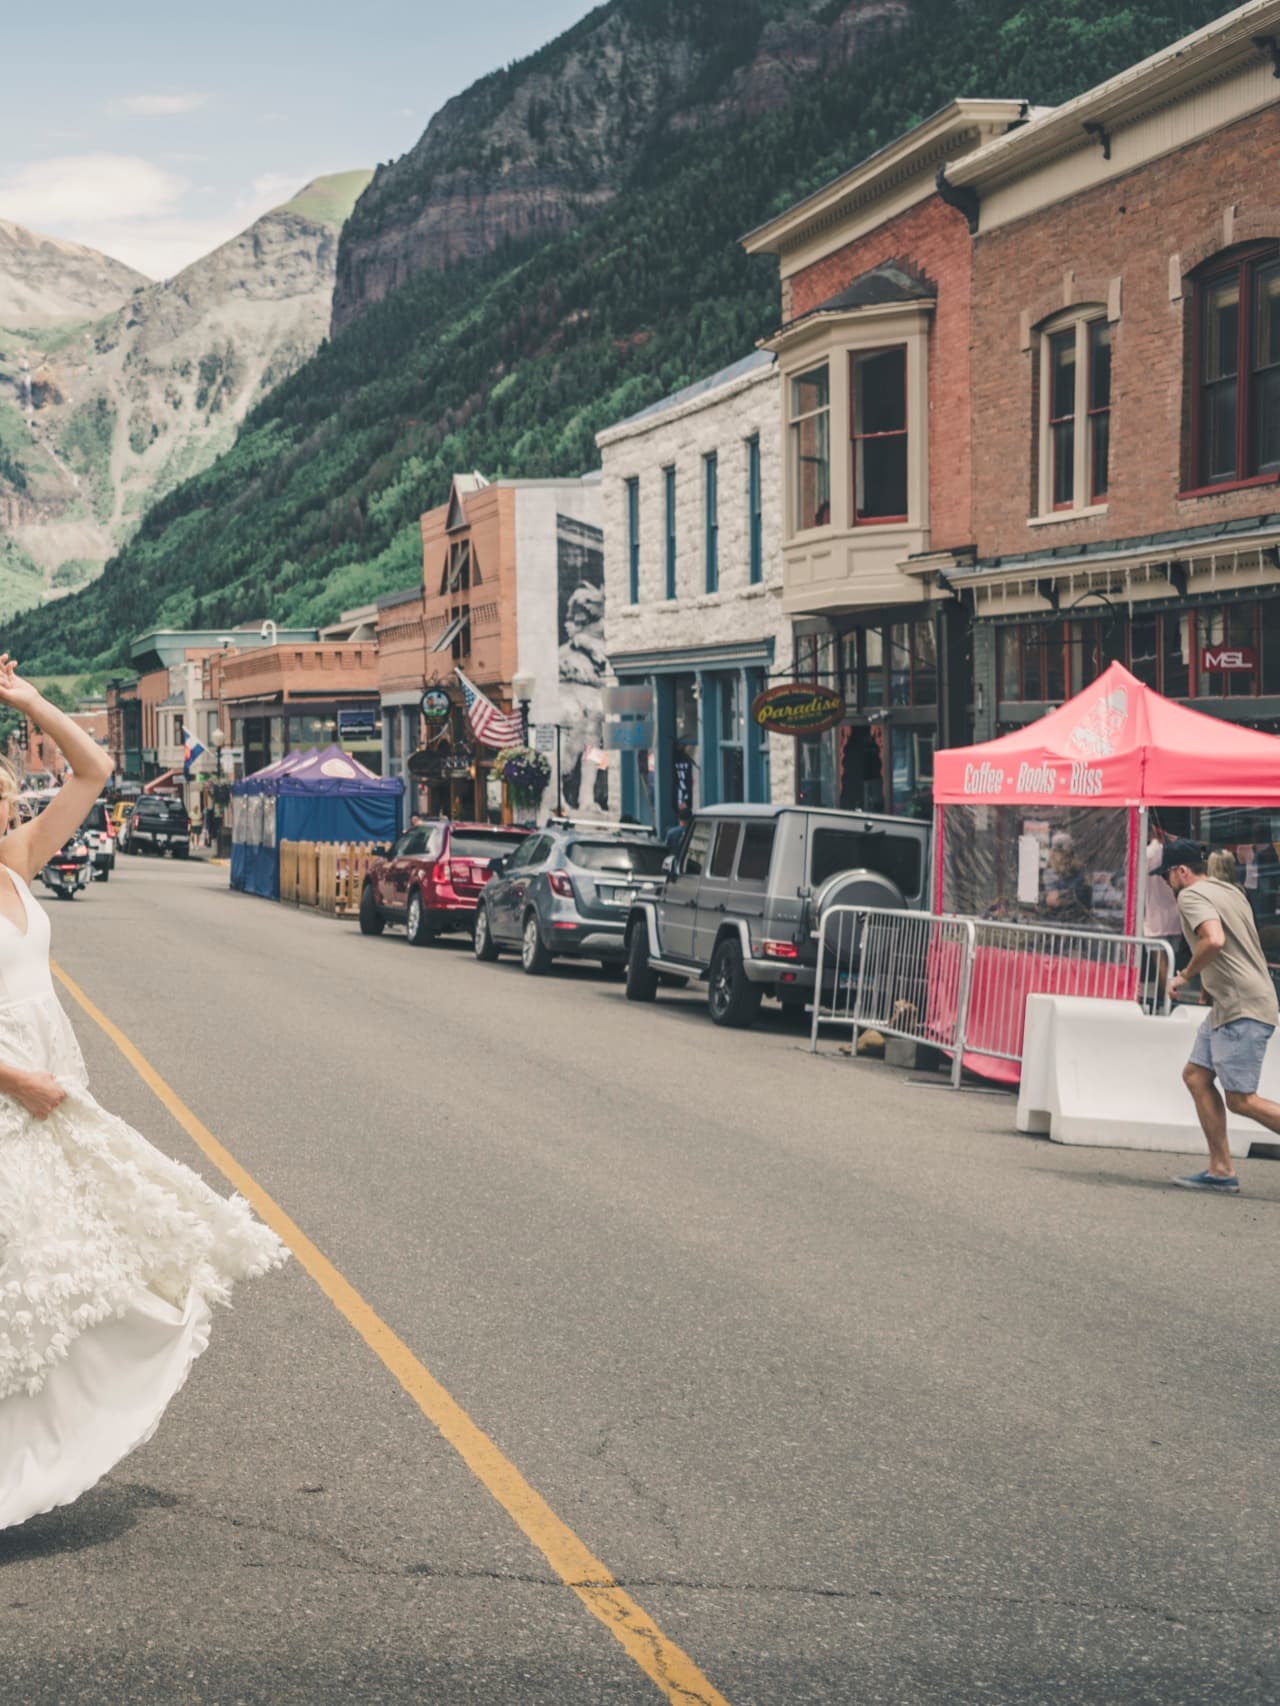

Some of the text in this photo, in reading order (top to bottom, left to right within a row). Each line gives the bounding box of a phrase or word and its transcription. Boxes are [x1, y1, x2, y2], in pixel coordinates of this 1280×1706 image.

[1206, 652, 1253, 668] MSL
[758, 697, 840, 723] Paradise
[964, 761, 1103, 795] Coffee Books Bliss
